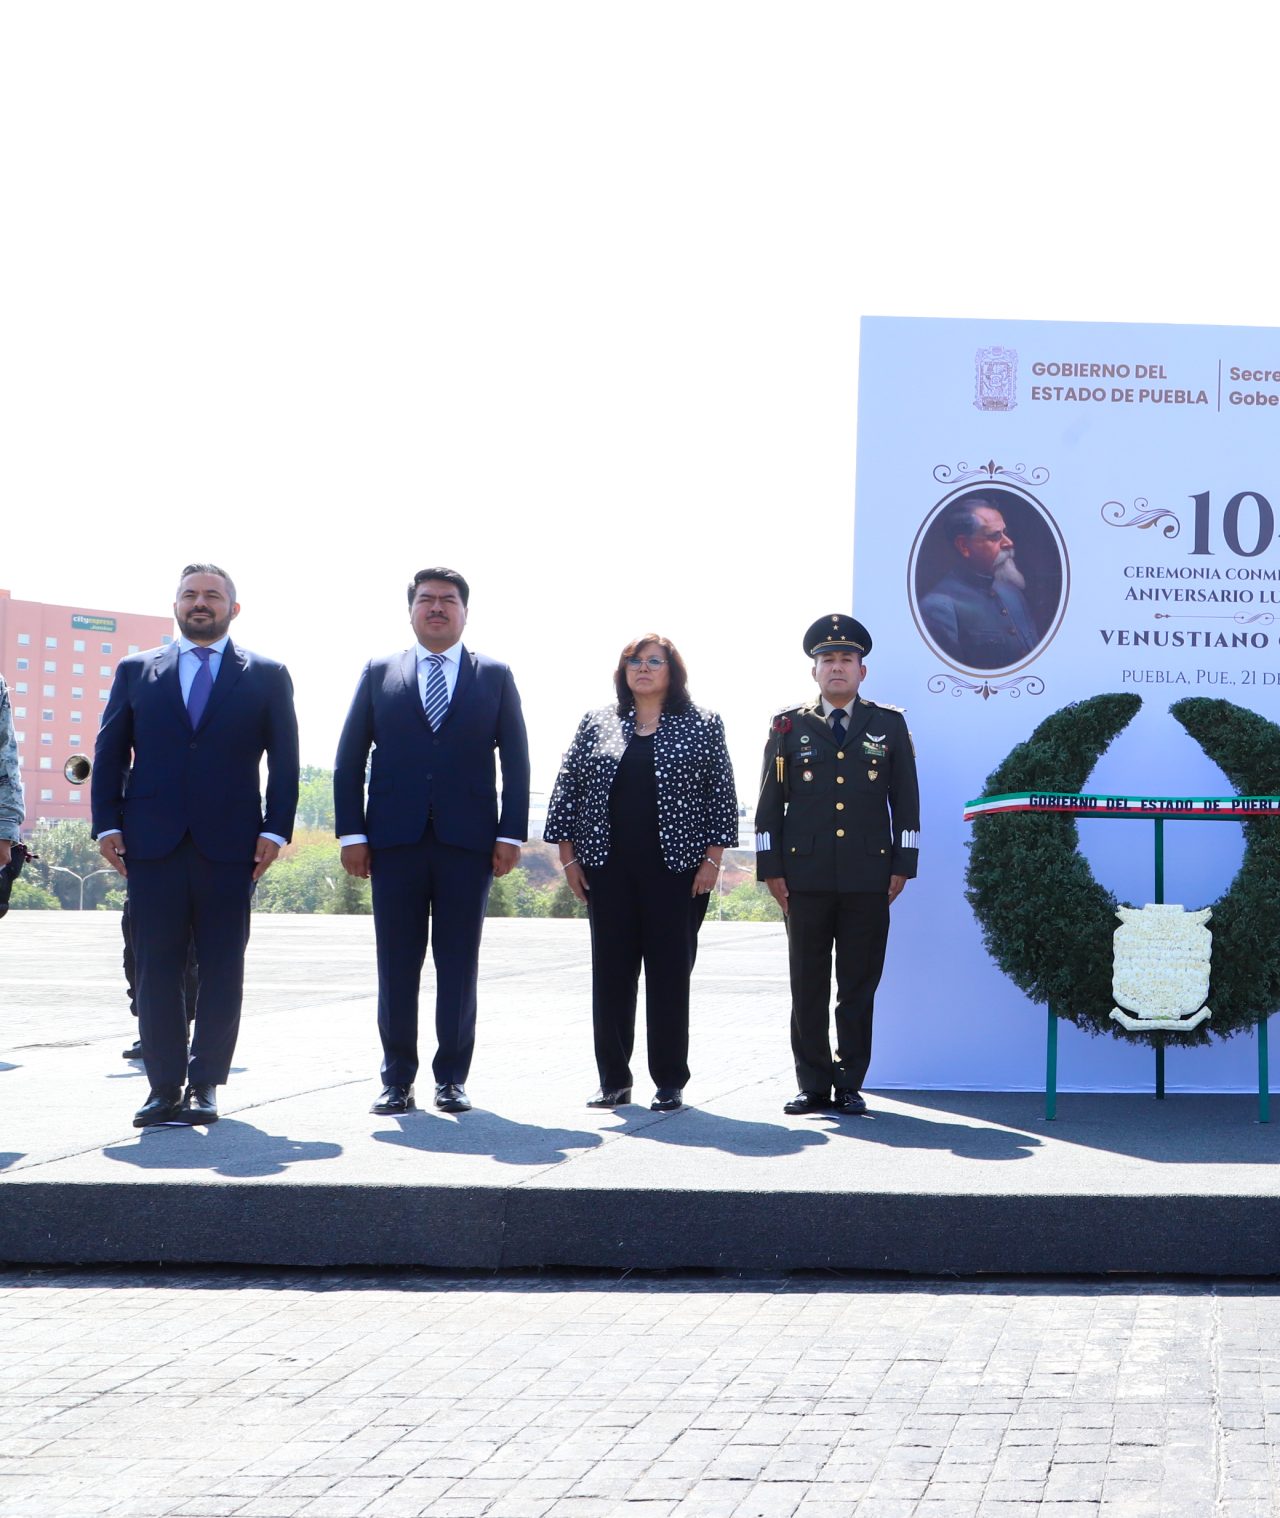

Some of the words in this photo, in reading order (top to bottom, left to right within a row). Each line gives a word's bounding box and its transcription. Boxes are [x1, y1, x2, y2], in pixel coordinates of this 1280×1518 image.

[1031, 361, 1131, 379] GOBIERNO
[1134, 364, 1168, 380] DEL
[1031, 386, 1107, 402] ESTADO
[1110, 387, 1135, 403] DE
[1138, 388, 1209, 405] PUEBLA
[1123, 566, 1222, 580] CEREMONIA
[1124, 585, 1254, 604] ANIVERSARIO
[1099, 629, 1269, 649] VENUSTIANO
[1122, 669, 1191, 685] PUEBLA,
[1196, 669, 1236, 686] PUE.,
[1241, 669, 1257, 685] 21
[1029, 794, 1098, 811] GOBIERNO
[1106, 798, 1131, 811] DEL
[1140, 799, 1193, 812] ESTADO
[1203, 800, 1221, 812] DE
